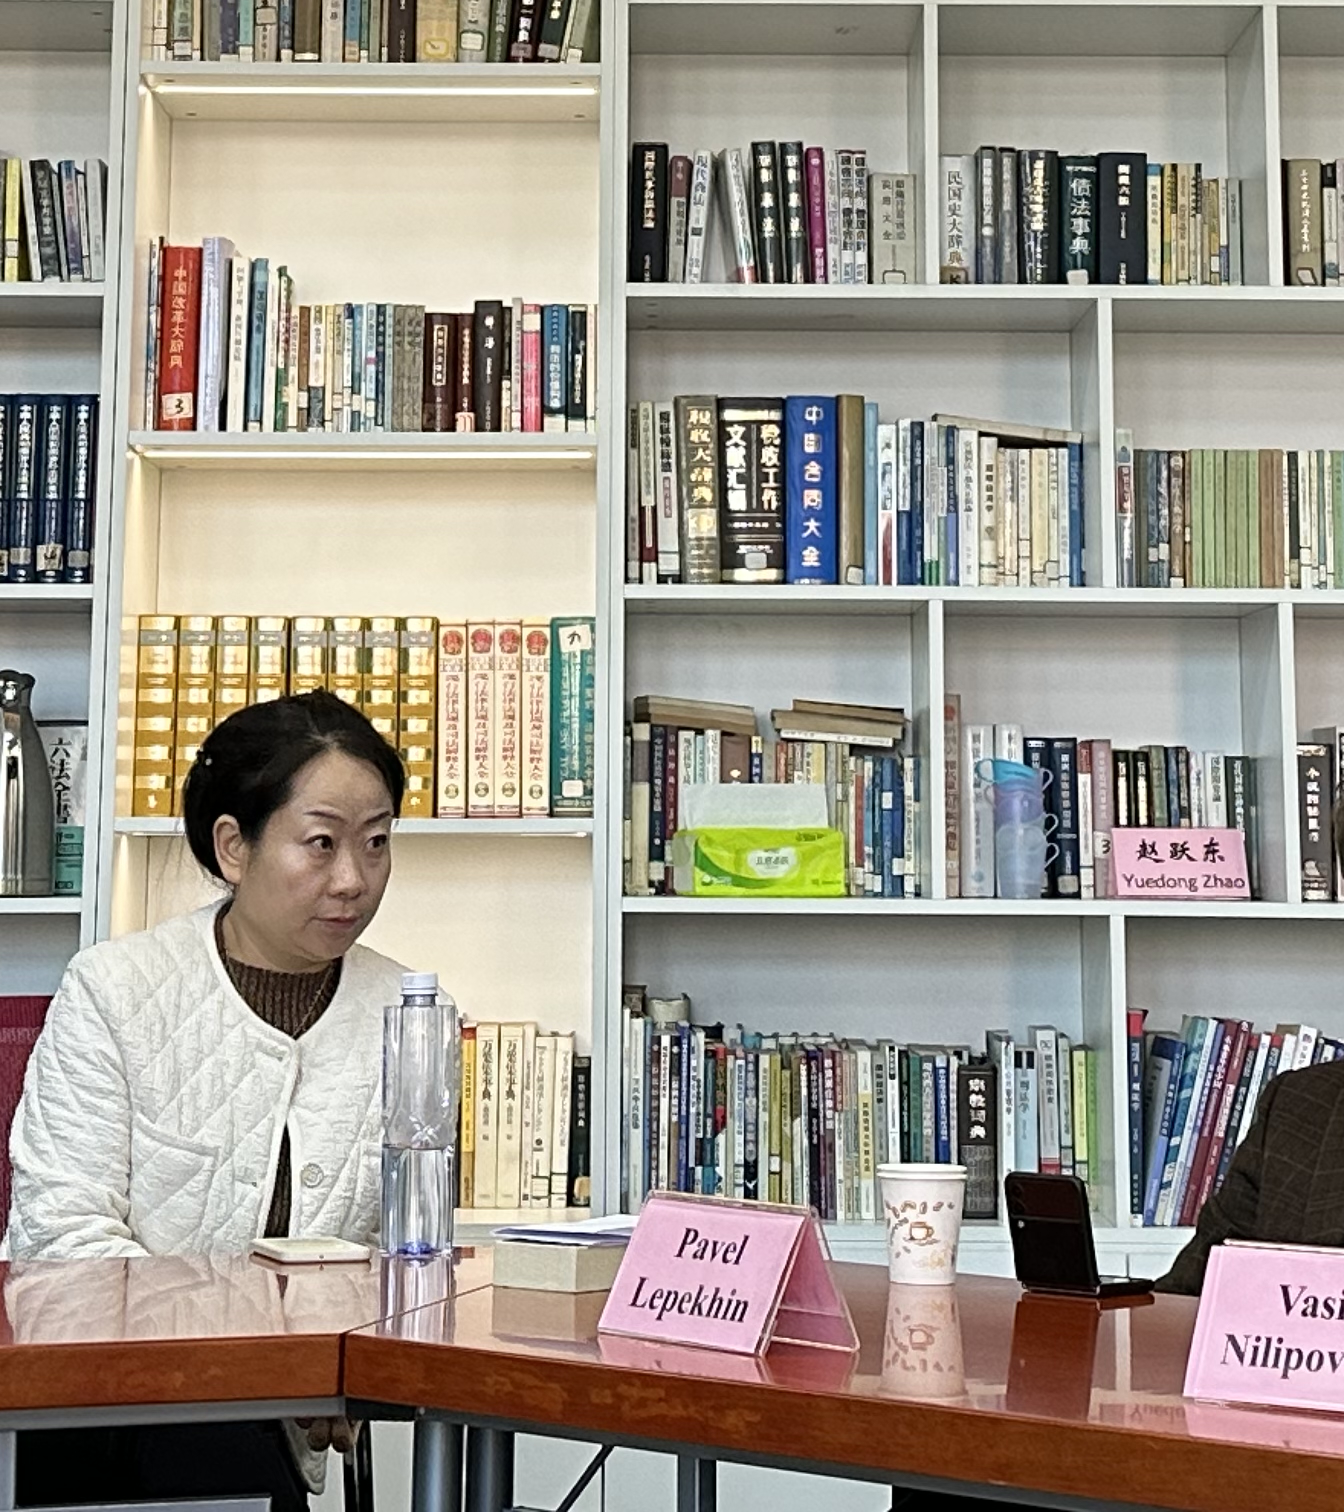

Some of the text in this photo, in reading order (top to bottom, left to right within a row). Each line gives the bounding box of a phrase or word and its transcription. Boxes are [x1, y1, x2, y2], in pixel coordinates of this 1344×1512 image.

[801, 405, 824, 567] 中国合同大全
[1135, 836, 1226, 864] 赵跃东
[1121, 873, 1246, 893] Yuedong Zhao
[674, 1227, 749, 1266] Pavel
[629, 1276, 749, 1323] Lepekhin
